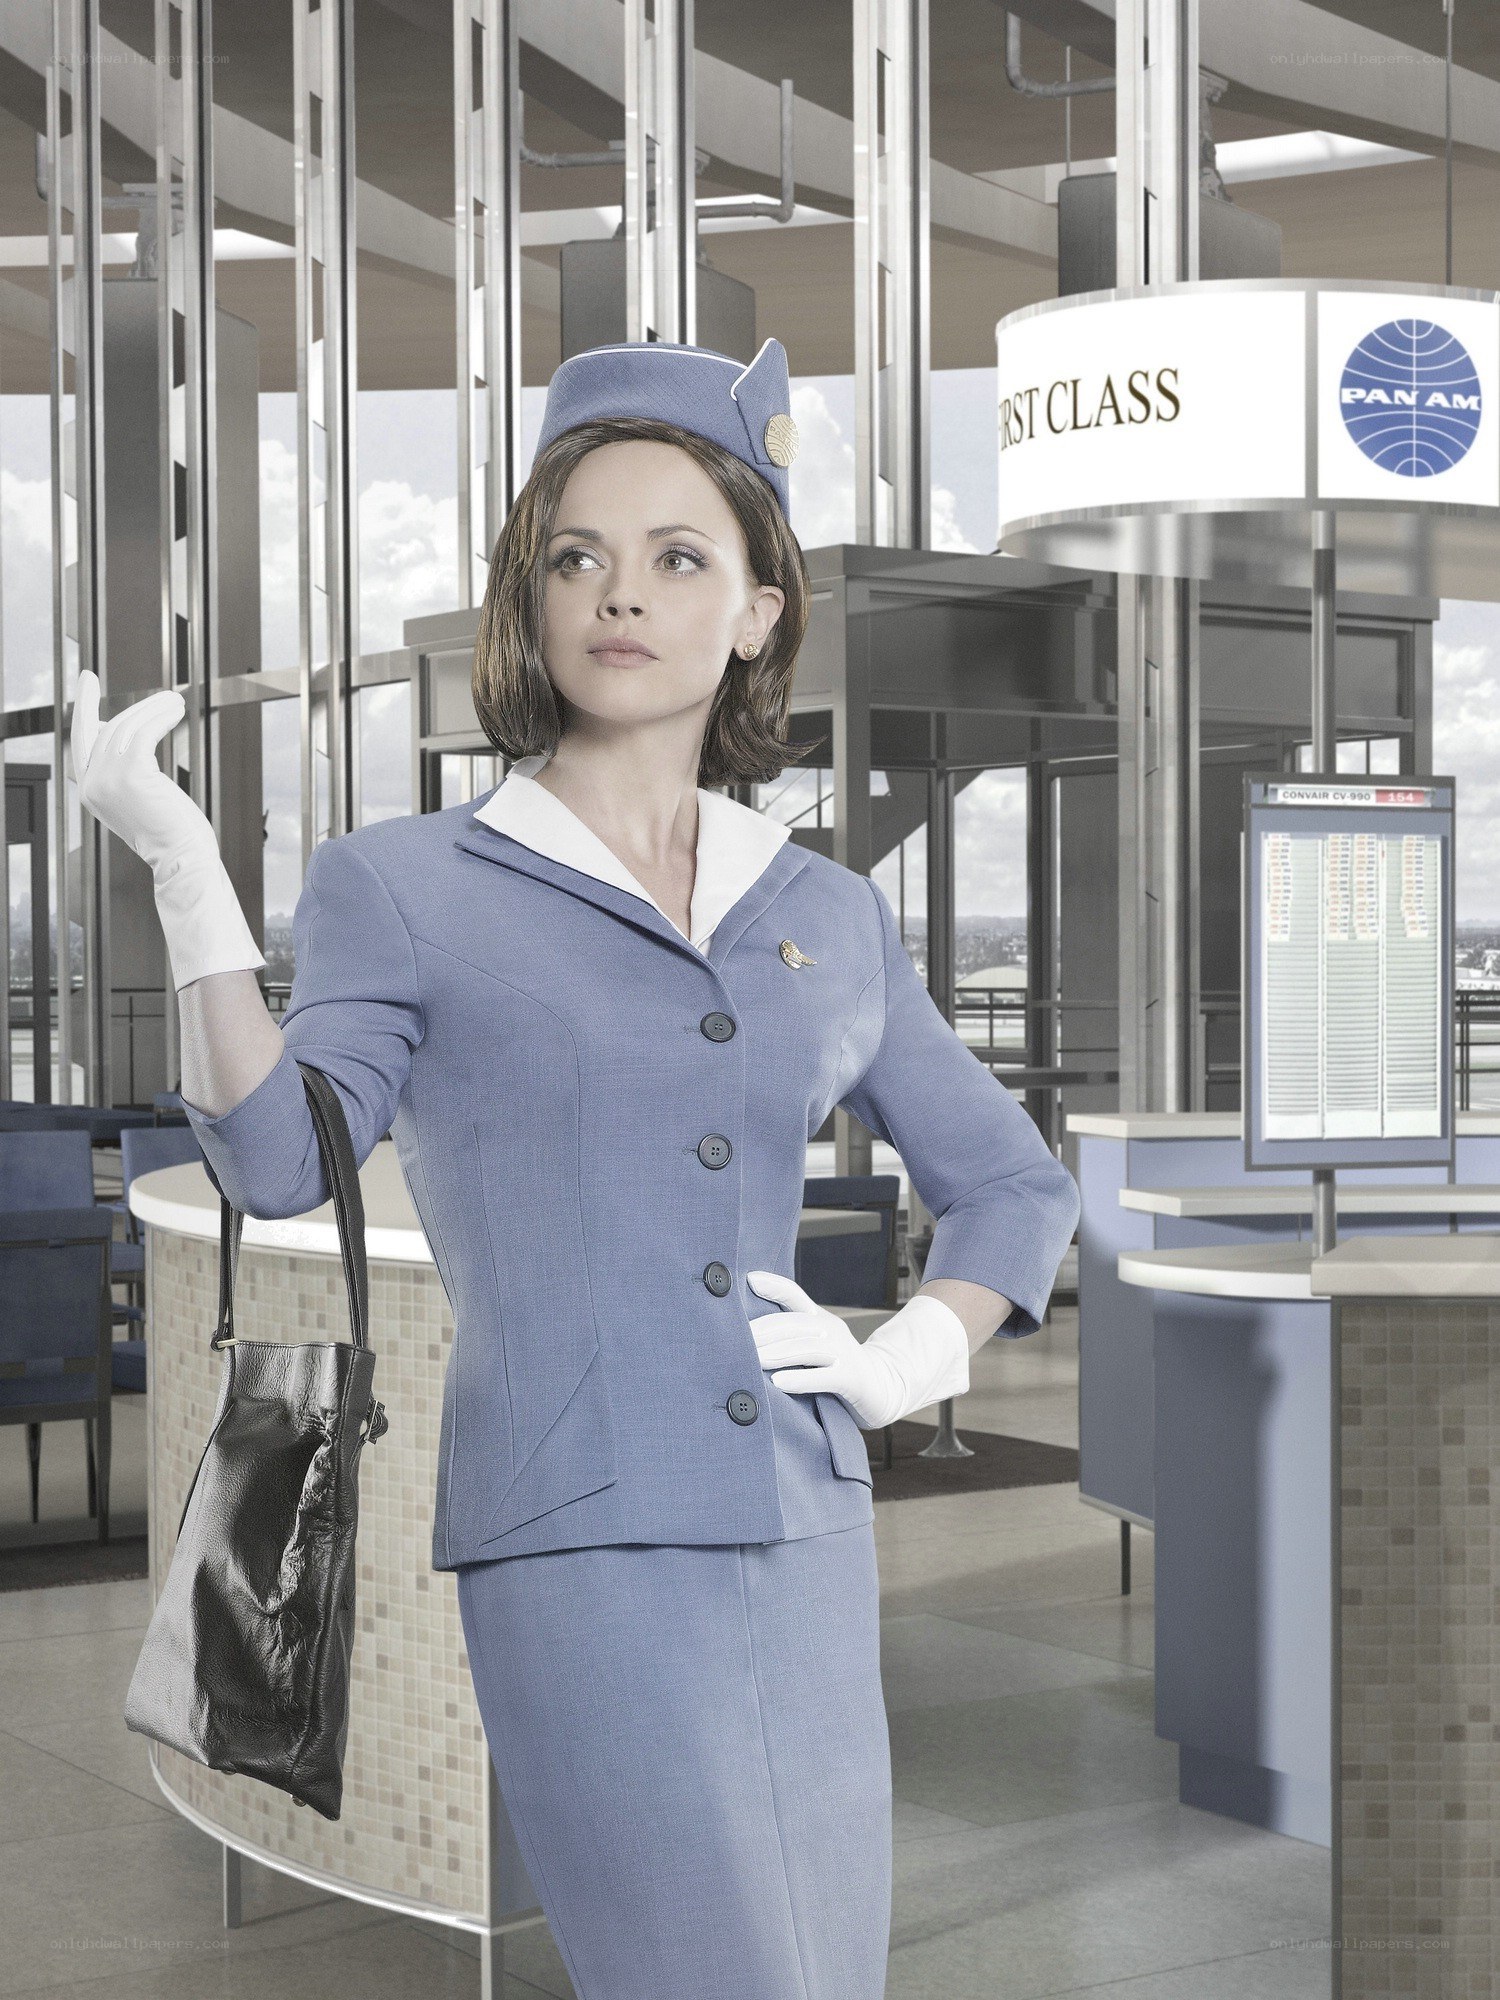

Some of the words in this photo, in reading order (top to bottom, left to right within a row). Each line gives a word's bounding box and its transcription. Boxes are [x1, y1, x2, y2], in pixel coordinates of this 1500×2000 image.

[1047, 368, 1181, 434] CLASS
[1341, 387, 1419, 406] PAN
[1424, 391, 1481, 411] AM
[1282, 790, 1329, 800] CONVAIR
[1333, 791, 1371, 801] CV-990
[1387, 791, 1415, 803] 154
